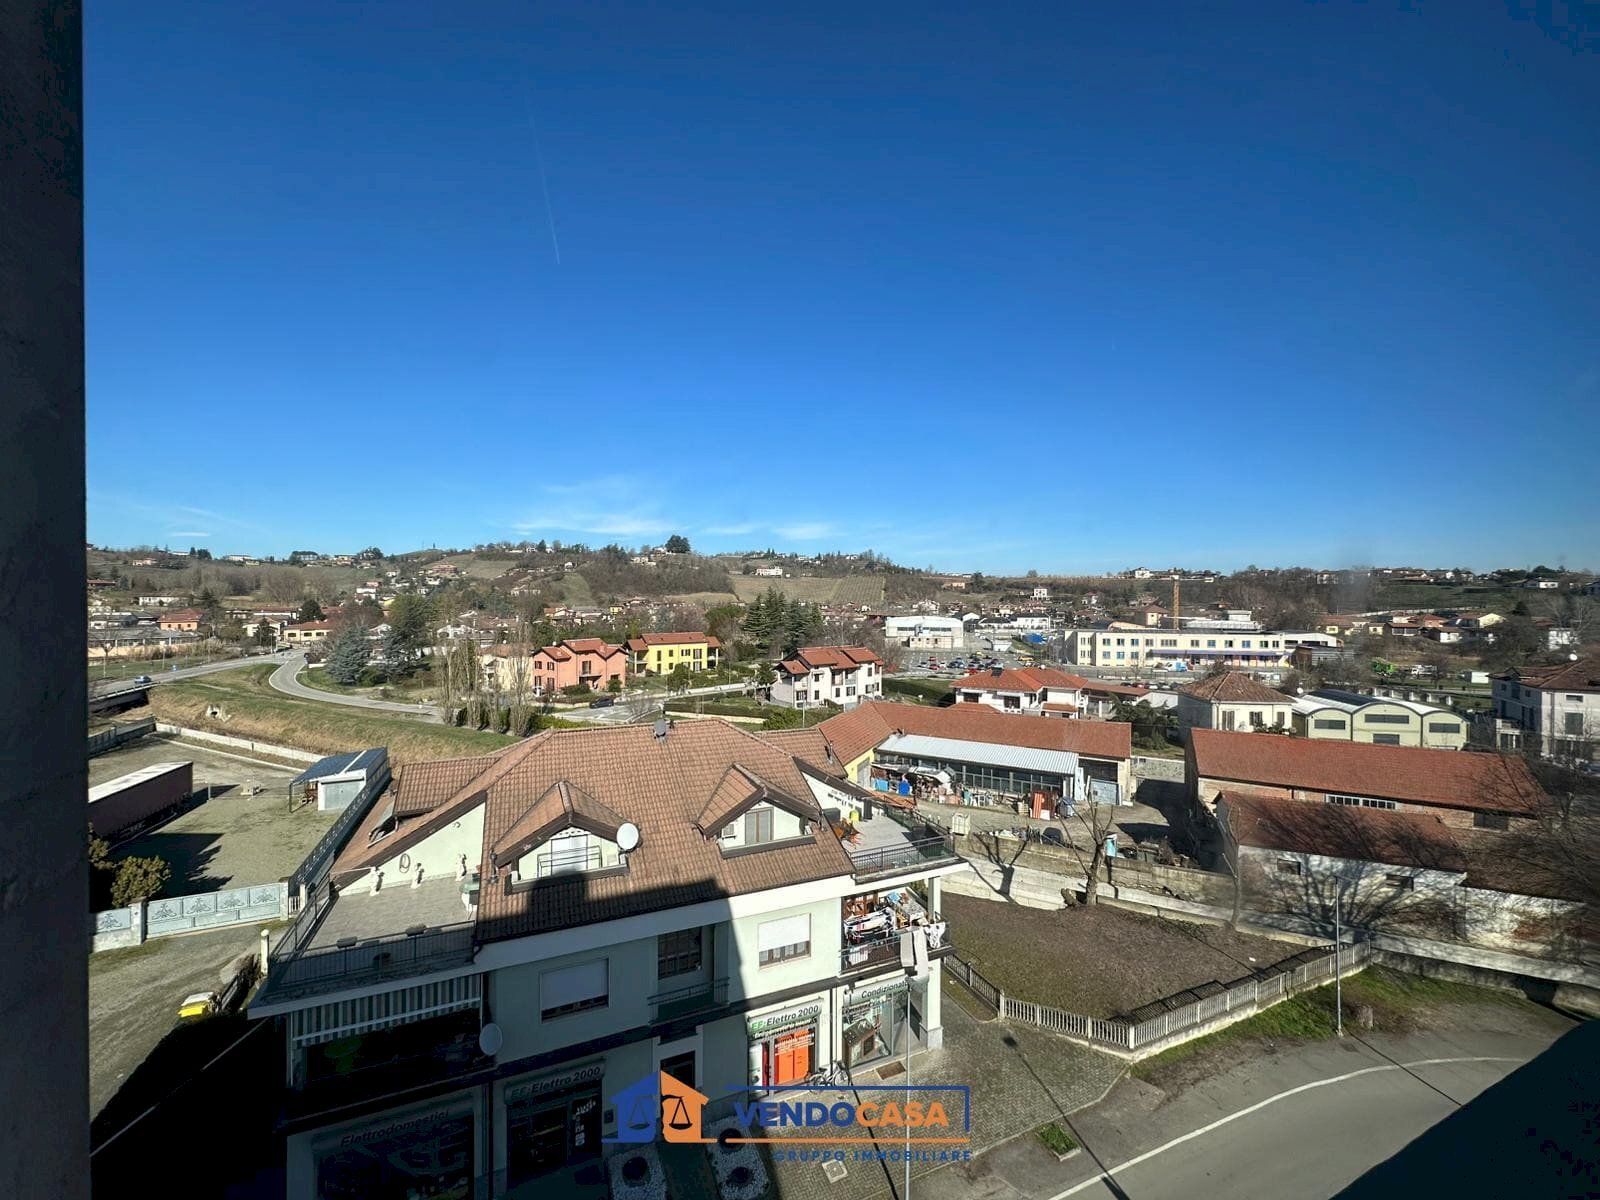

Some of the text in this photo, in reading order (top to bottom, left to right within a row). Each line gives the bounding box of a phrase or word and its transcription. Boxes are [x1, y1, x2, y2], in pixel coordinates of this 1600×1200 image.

[798, 1005, 819, 1018] 2000
[573, 1066, 600, 1081] 2000
[340, 1110, 449, 1147] Elettrodomestici
